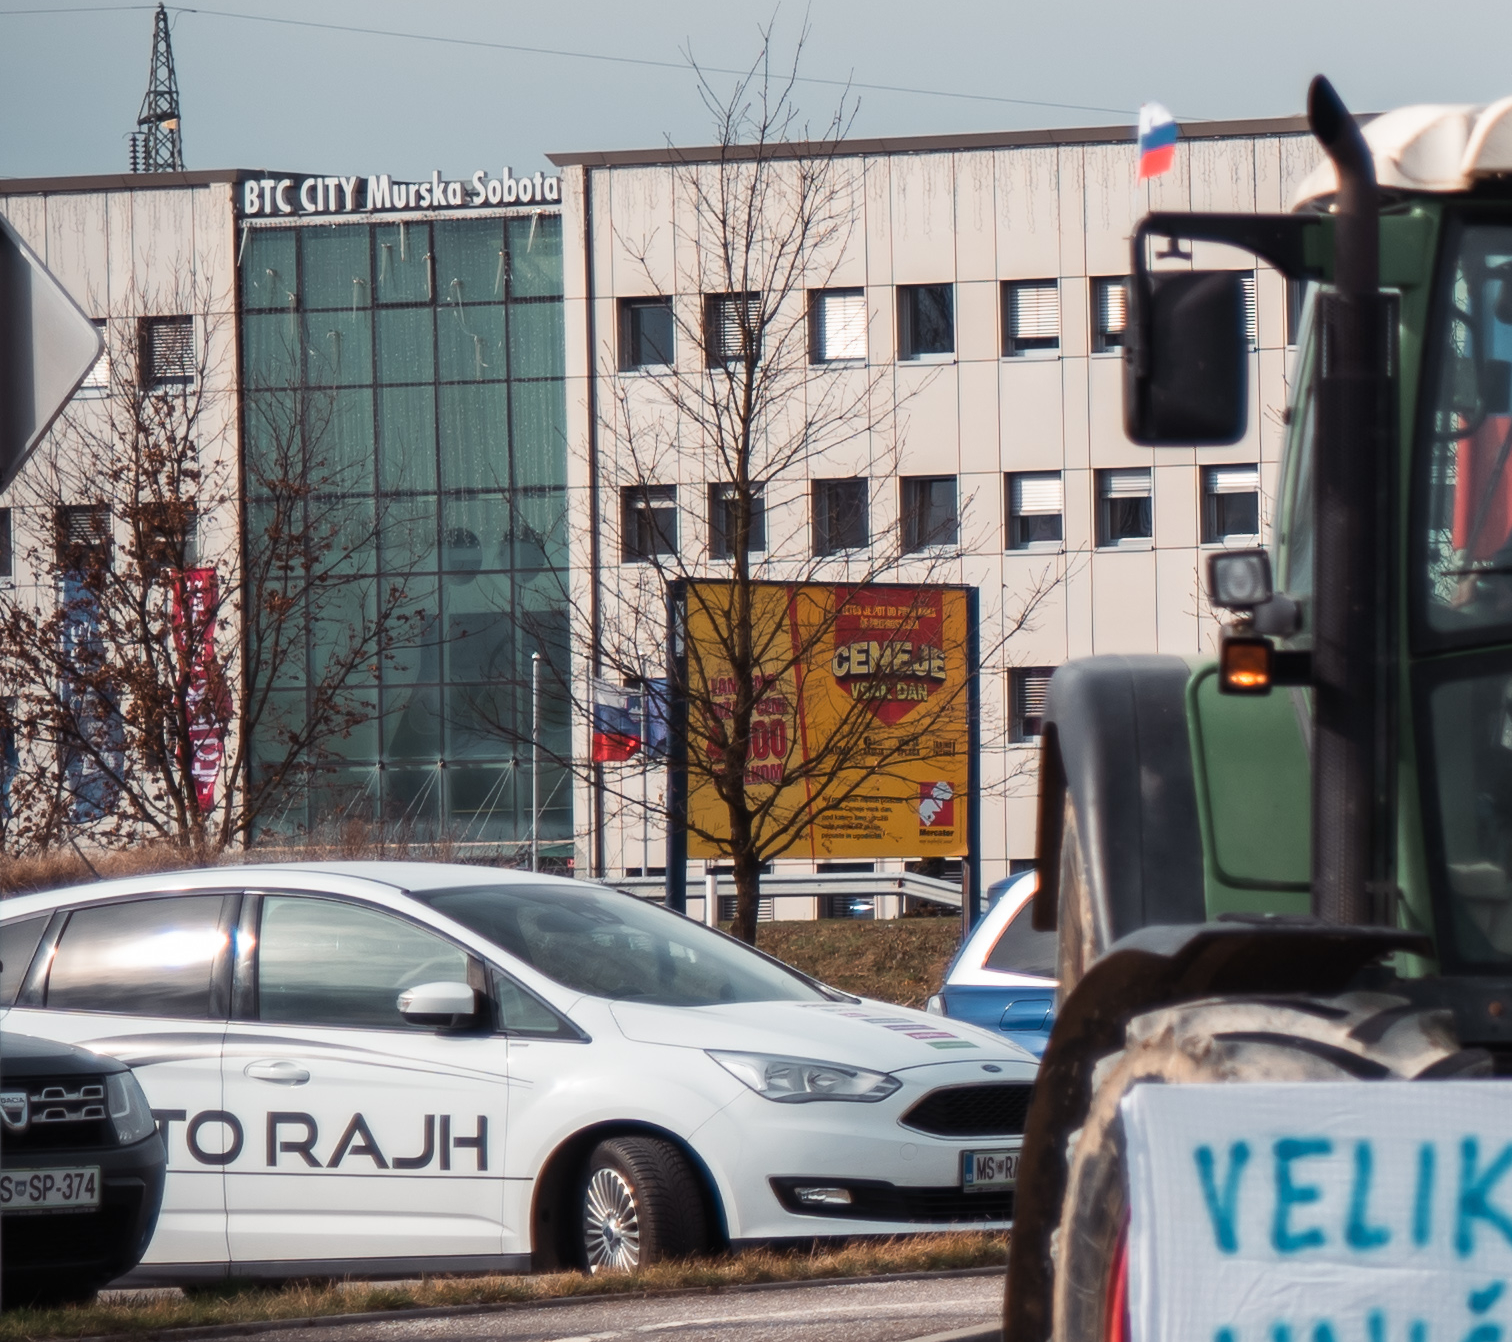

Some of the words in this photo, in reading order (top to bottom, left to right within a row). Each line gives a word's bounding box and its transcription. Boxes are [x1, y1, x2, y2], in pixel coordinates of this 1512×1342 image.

[244, 178, 294, 214] BTC
[300, 175, 360, 212] CITY
[367, 169, 464, 208] Murska
[472, 166, 562, 204] Sobota
[897, 682, 928, 702] DAN
[919, 829, 955, 837] Mercator
[265, 1111, 489, 1172] RAJH
[977, 1156, 994, 1181] MS
[0, 1176, 13, 1202] S
[29, 1172, 95, 1201] SP-374
